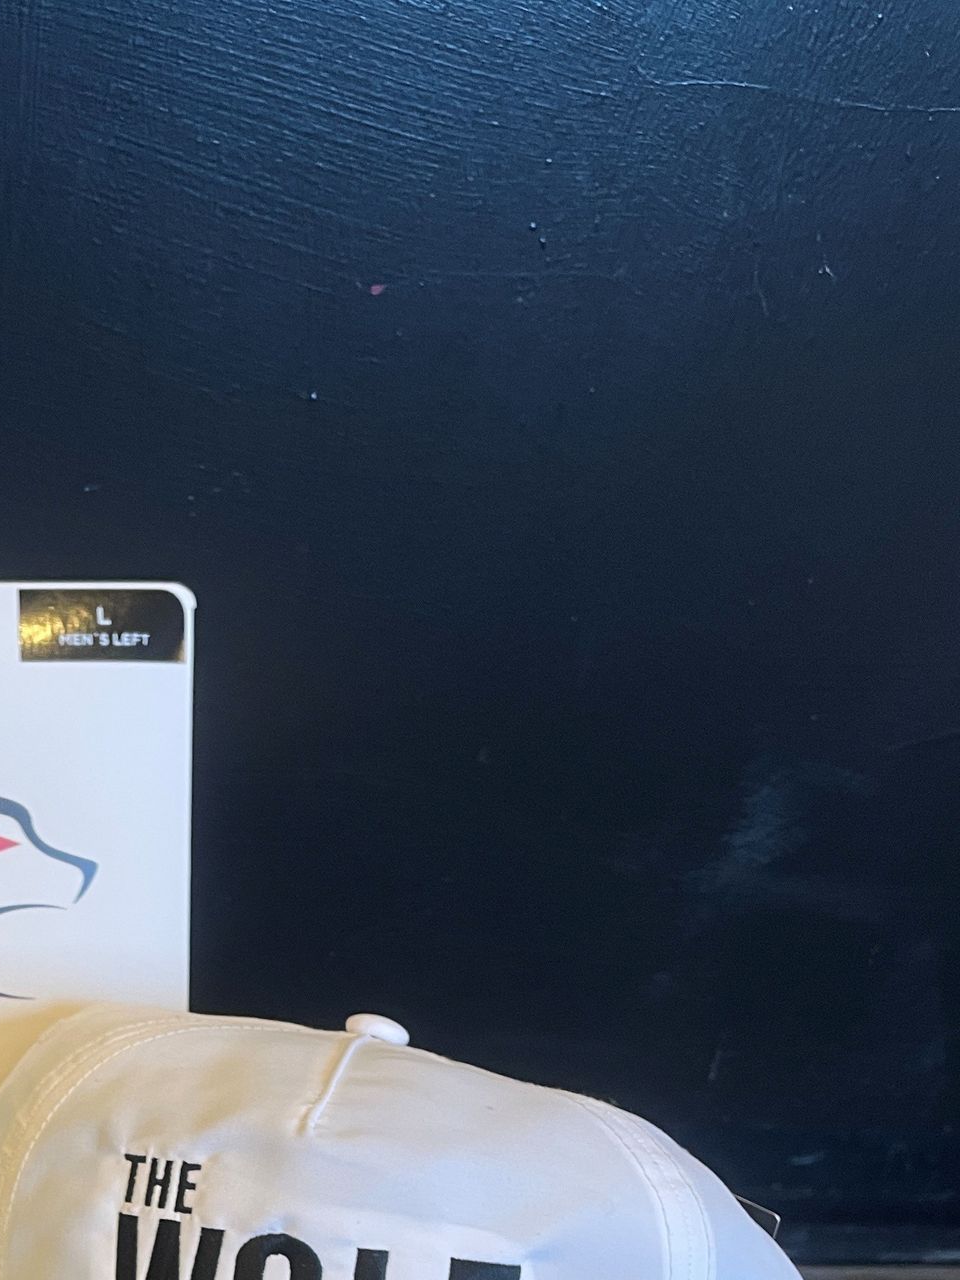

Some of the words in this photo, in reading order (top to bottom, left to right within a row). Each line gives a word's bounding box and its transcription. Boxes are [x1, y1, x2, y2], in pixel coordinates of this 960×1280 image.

[96, 605, 112, 626] L
[112, 632, 150, 646] LEFT
[124, 1153, 202, 1214] THE
